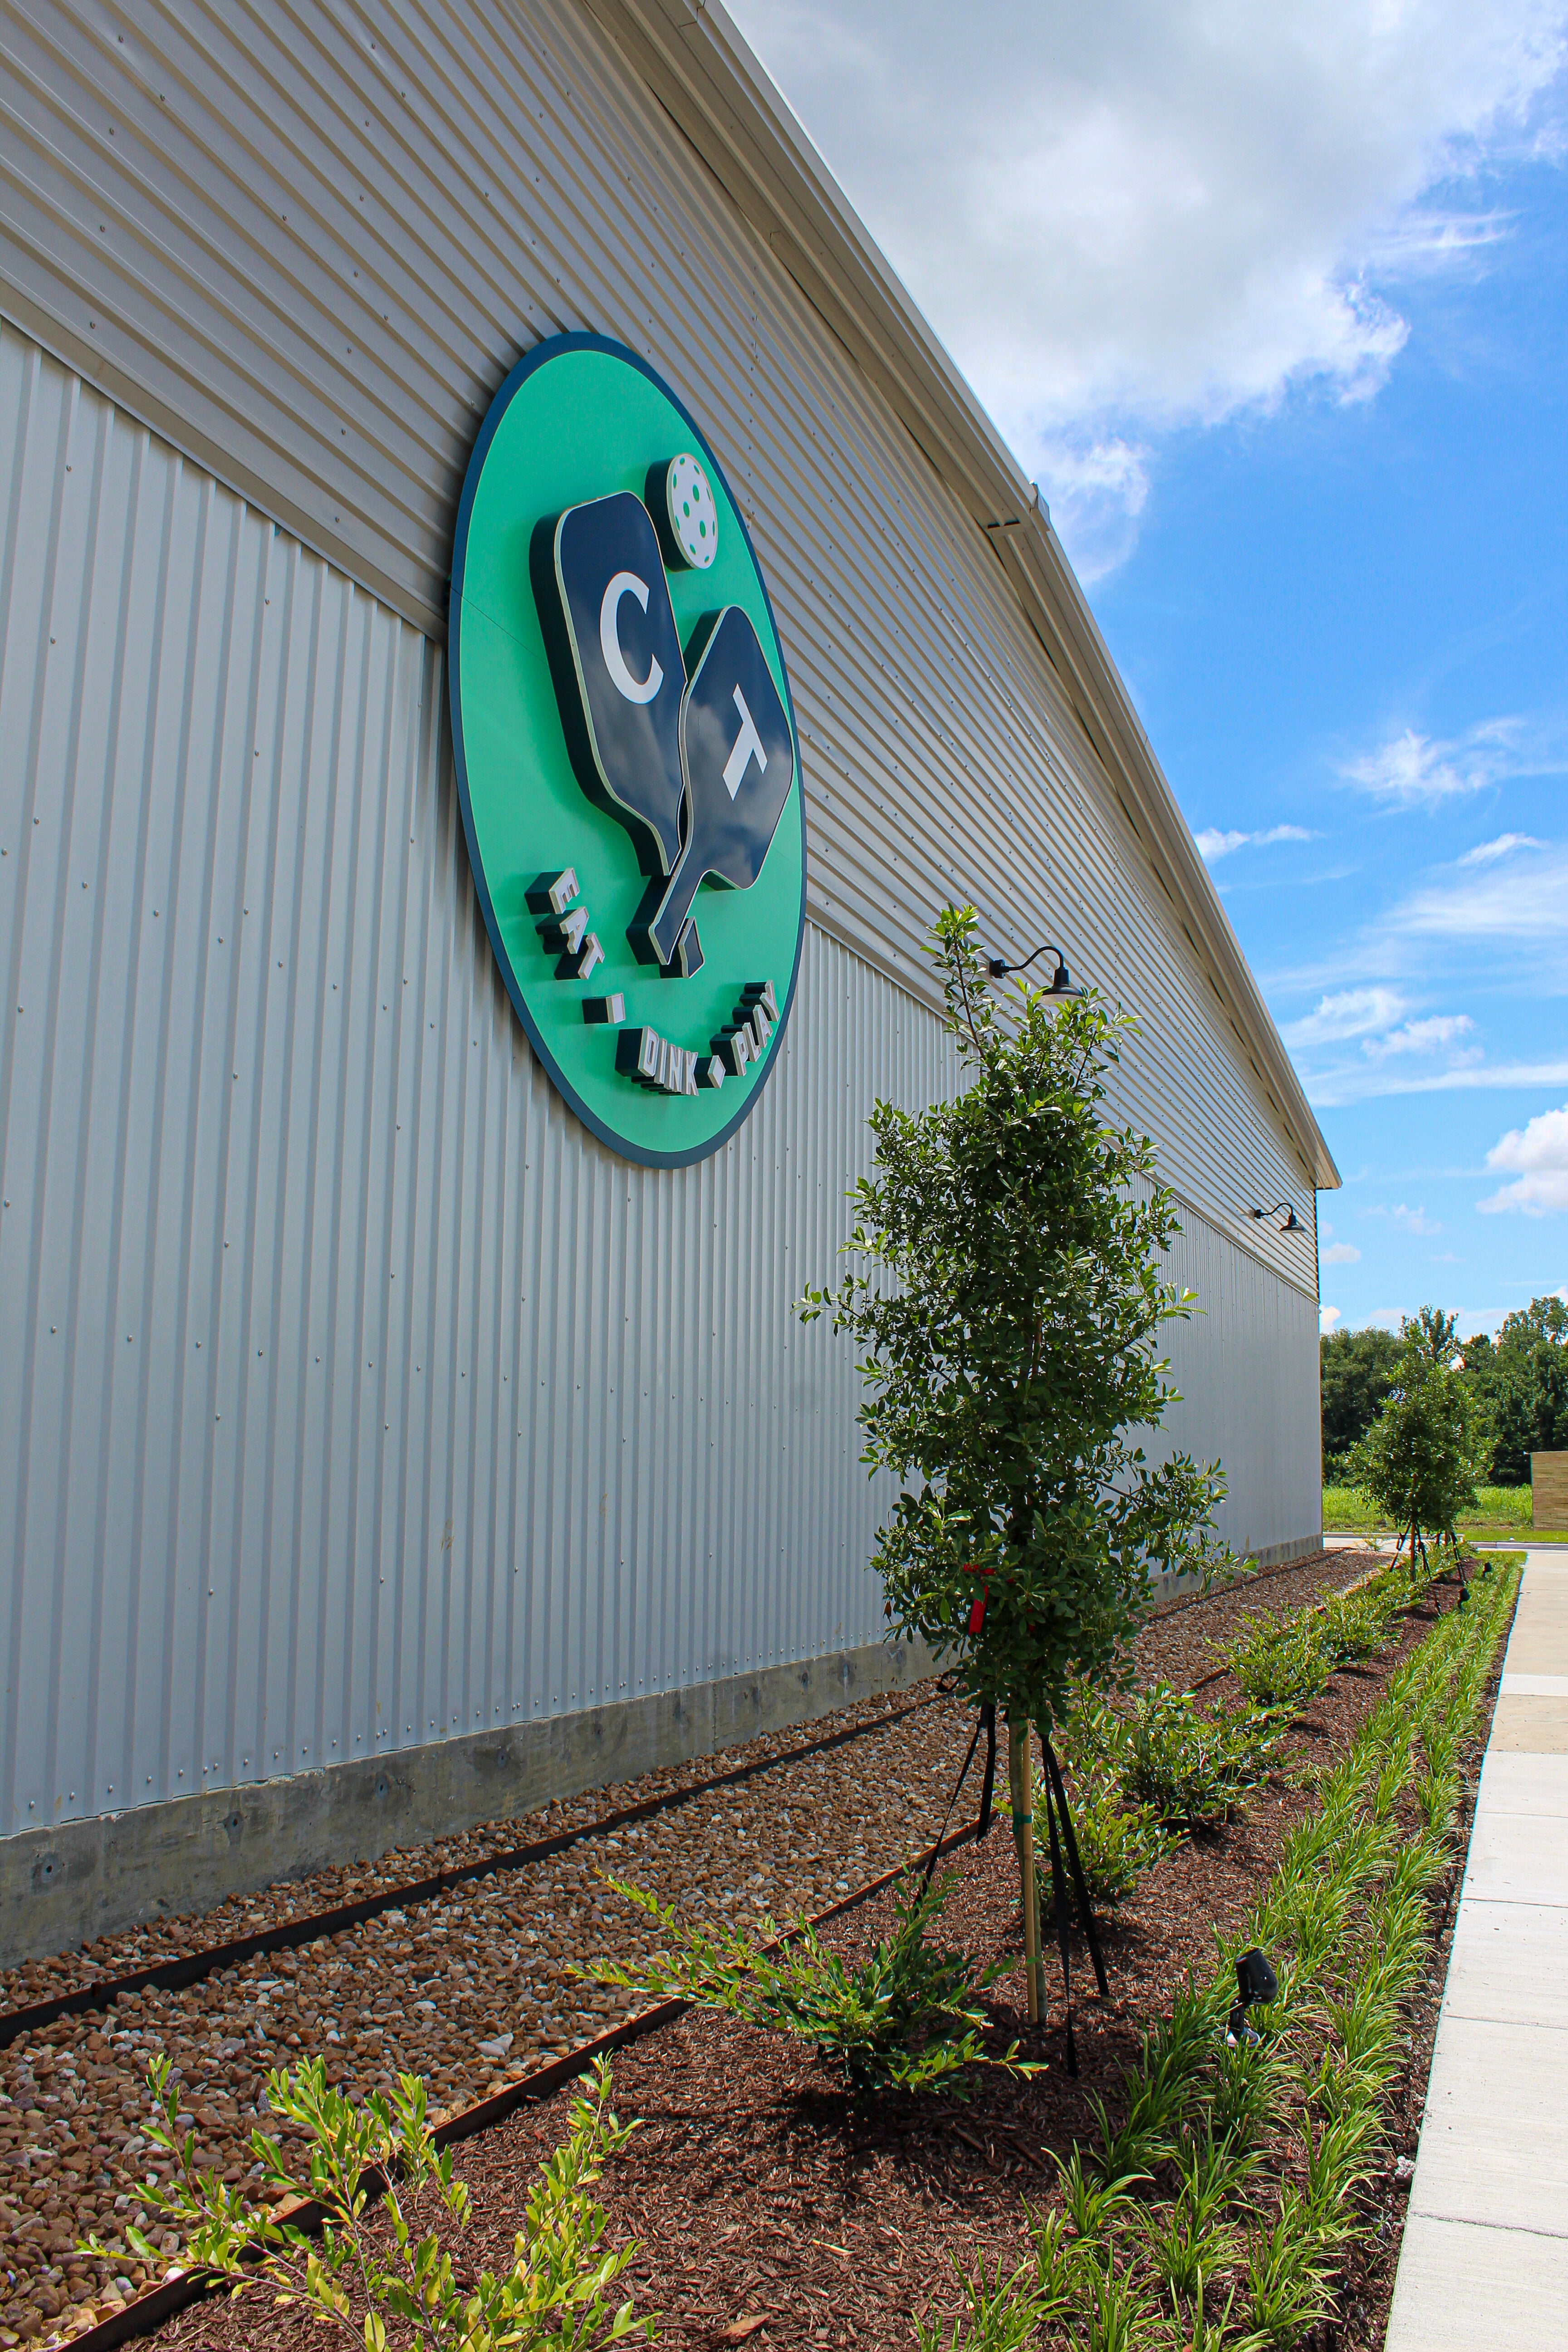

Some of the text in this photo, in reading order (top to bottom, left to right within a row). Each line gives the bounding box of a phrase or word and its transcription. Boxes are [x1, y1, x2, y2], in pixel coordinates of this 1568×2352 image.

[599, 571, 664, 705] C
[722, 682, 768, 802] T
[549, 867, 780, 1096] EAT DINK PLAY
